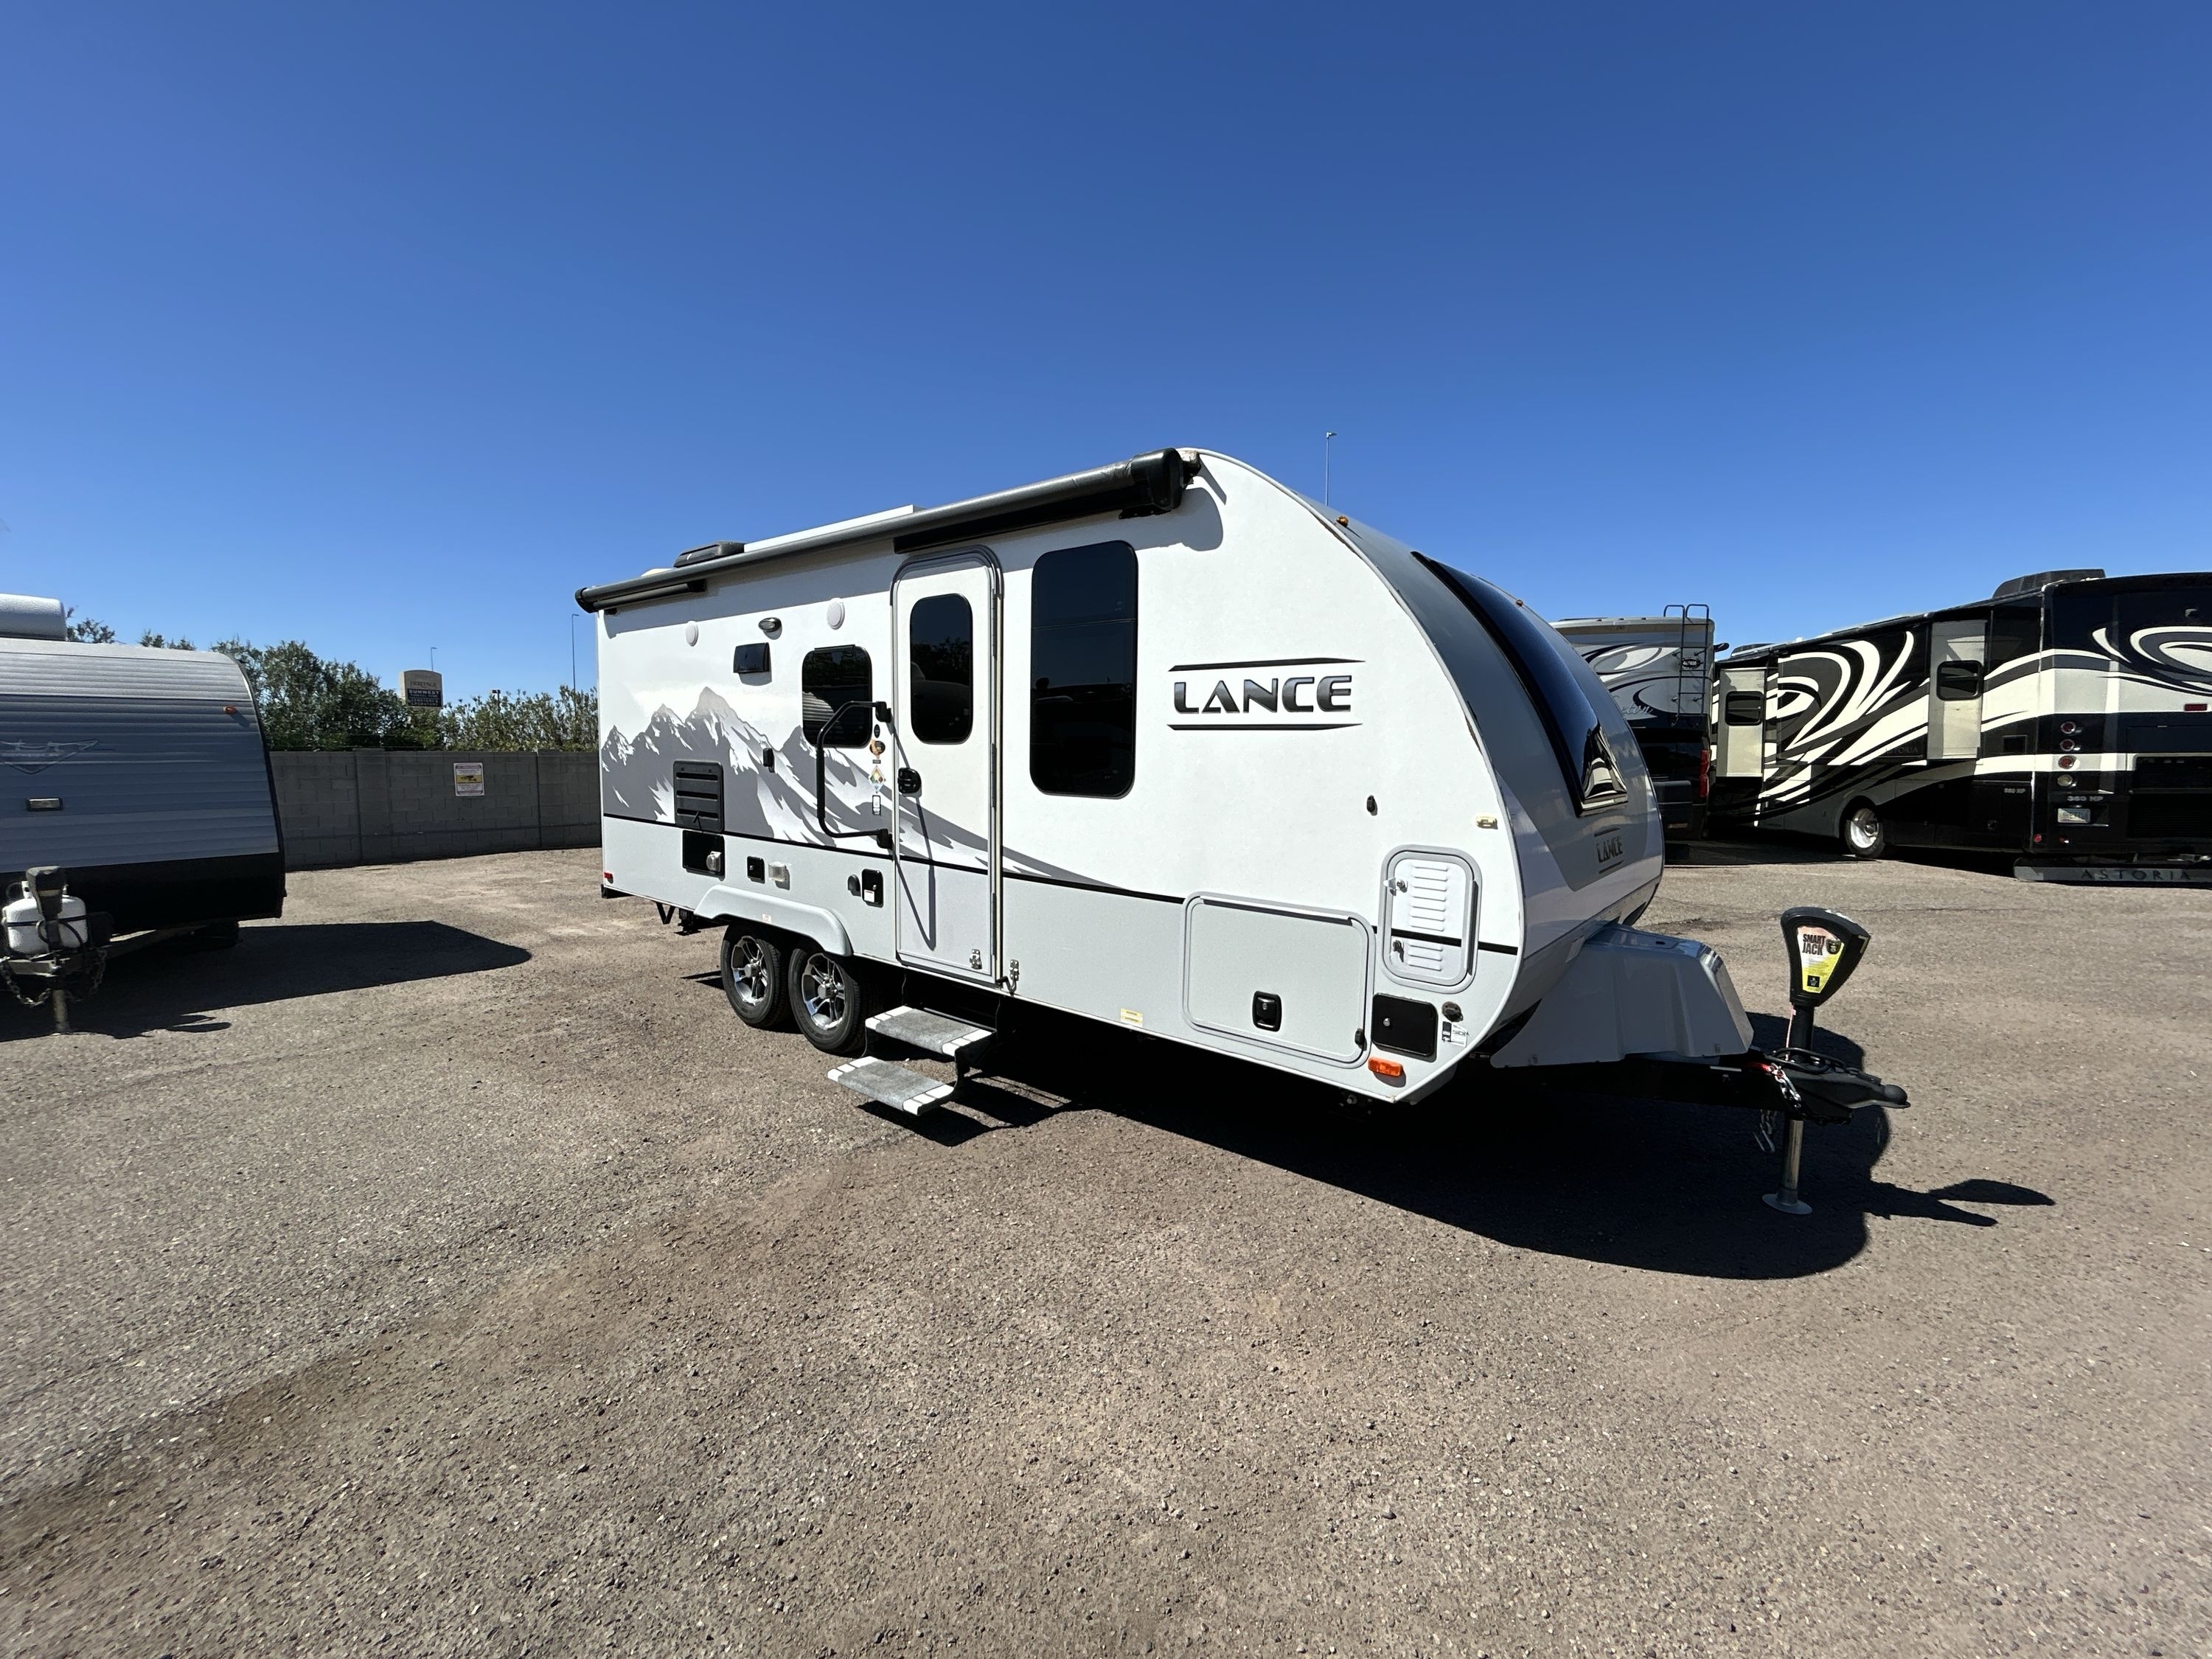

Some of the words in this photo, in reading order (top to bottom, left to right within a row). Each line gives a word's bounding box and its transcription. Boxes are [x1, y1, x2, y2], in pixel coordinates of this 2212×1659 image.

[1174, 675, 1352, 714] LANCE
[1596, 835, 1623, 863] LANCE
[2081, 869, 2191, 881] ASTORIA
[1803, 933, 1826, 945] SMART
[1802, 943, 1823, 956] JACK
